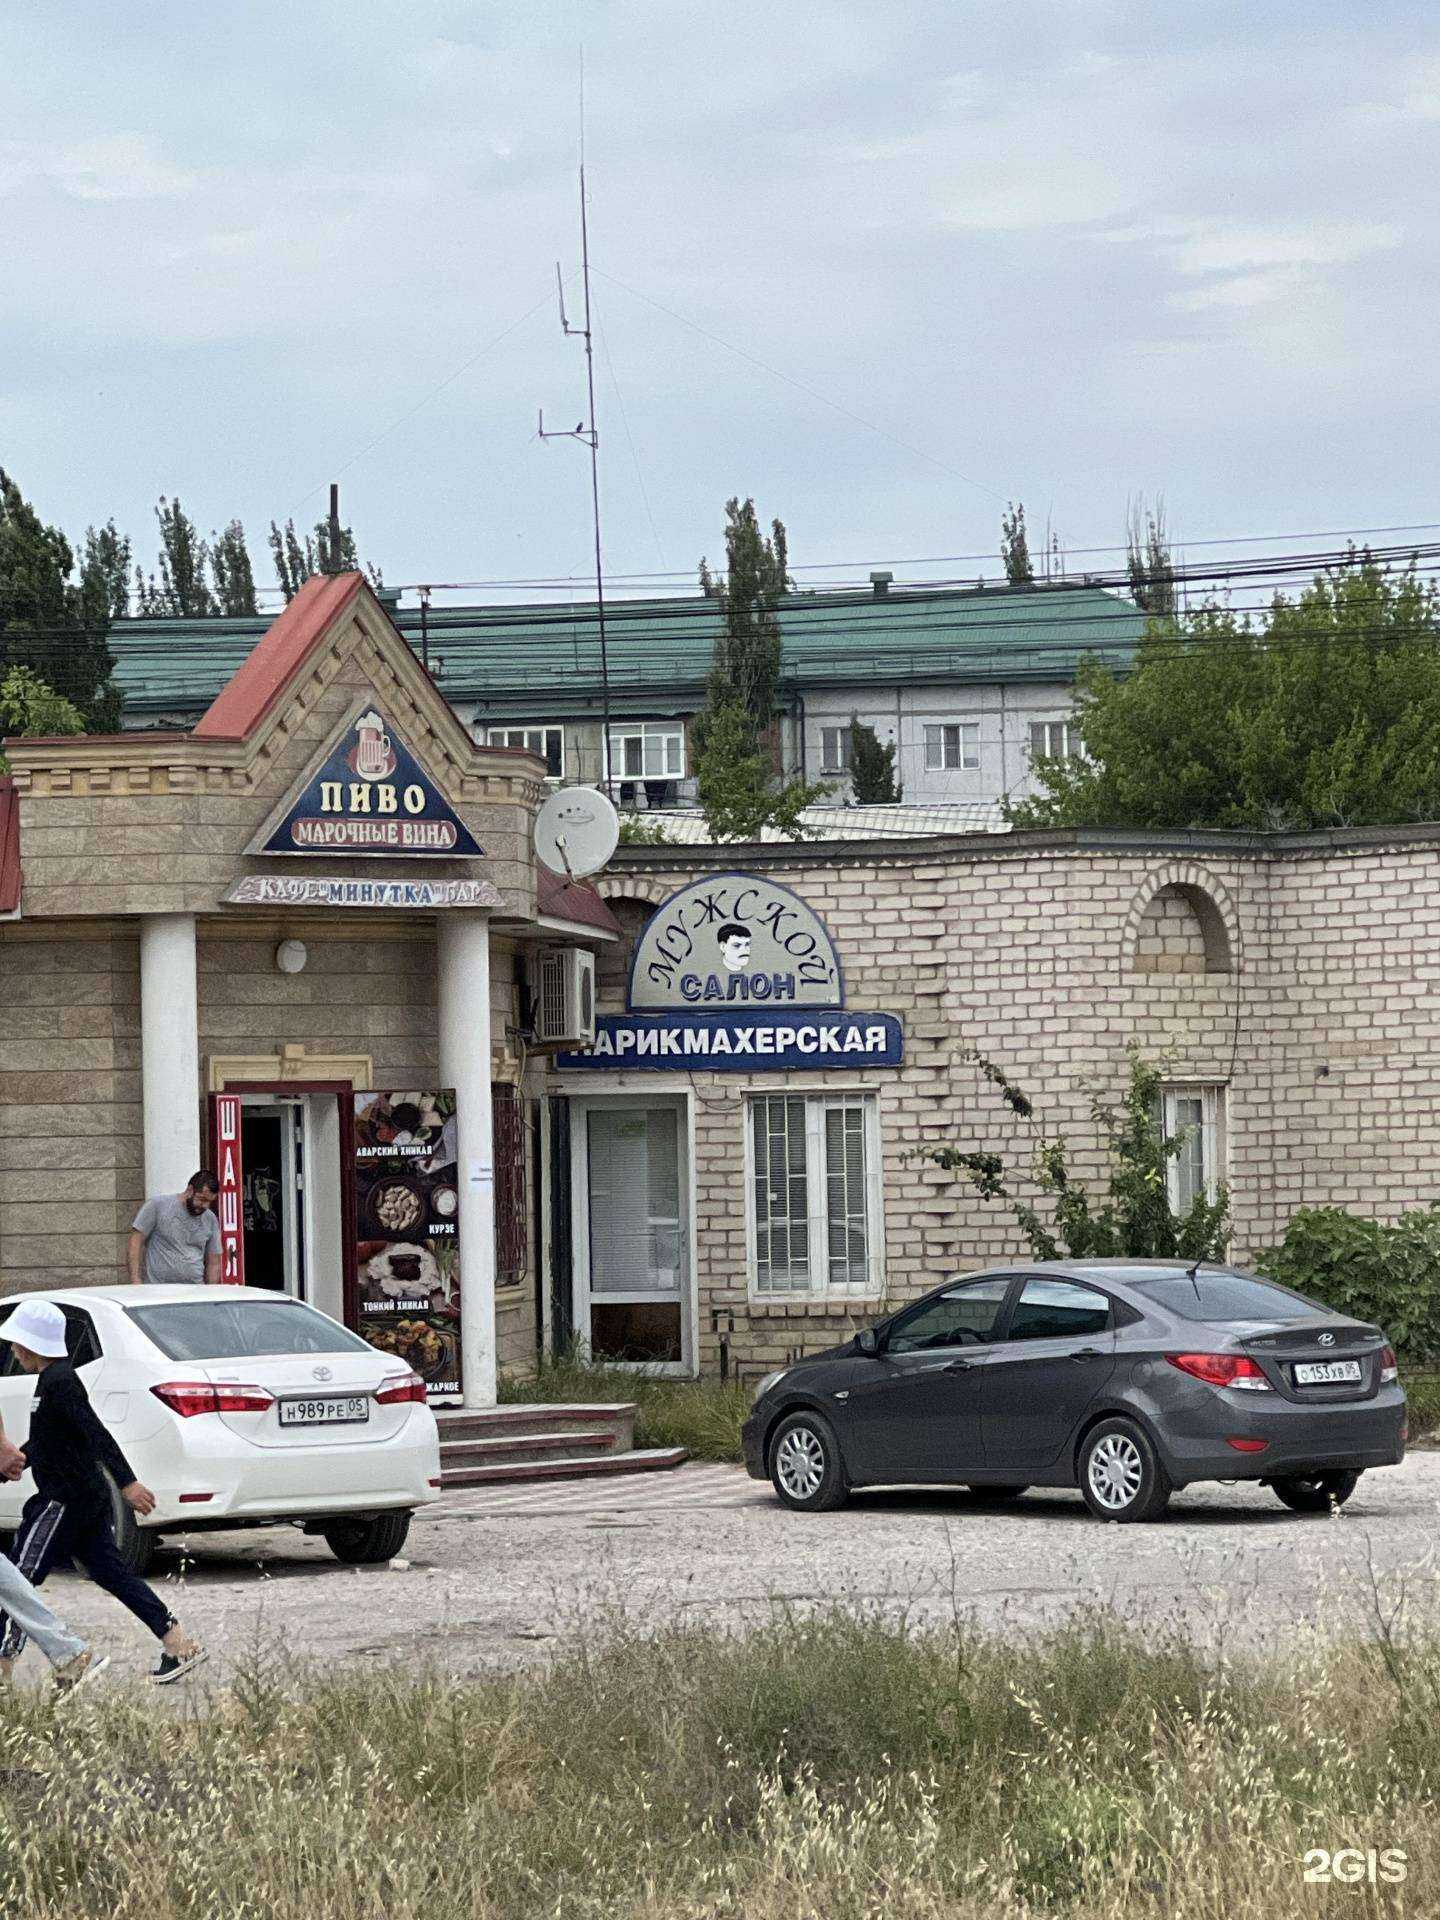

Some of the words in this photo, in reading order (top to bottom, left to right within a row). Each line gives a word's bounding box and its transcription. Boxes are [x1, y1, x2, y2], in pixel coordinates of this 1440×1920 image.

[320, 782, 426, 814] ПИВО
[297, 822, 398, 844] МАРОЧНЫЕ
[402, 823, 451, 845] ВИНА
[648, 890, 834, 990] МУЖСКОЙ
[680, 973, 796, 1001] САЛОН
[569, 1026, 887, 1056] АРИКМАХЕРСКАЯ
[356, 1145, 399, 1157] АВАРСКИЙ
[363, 1299, 395, 1312] ТОНКИЙ
